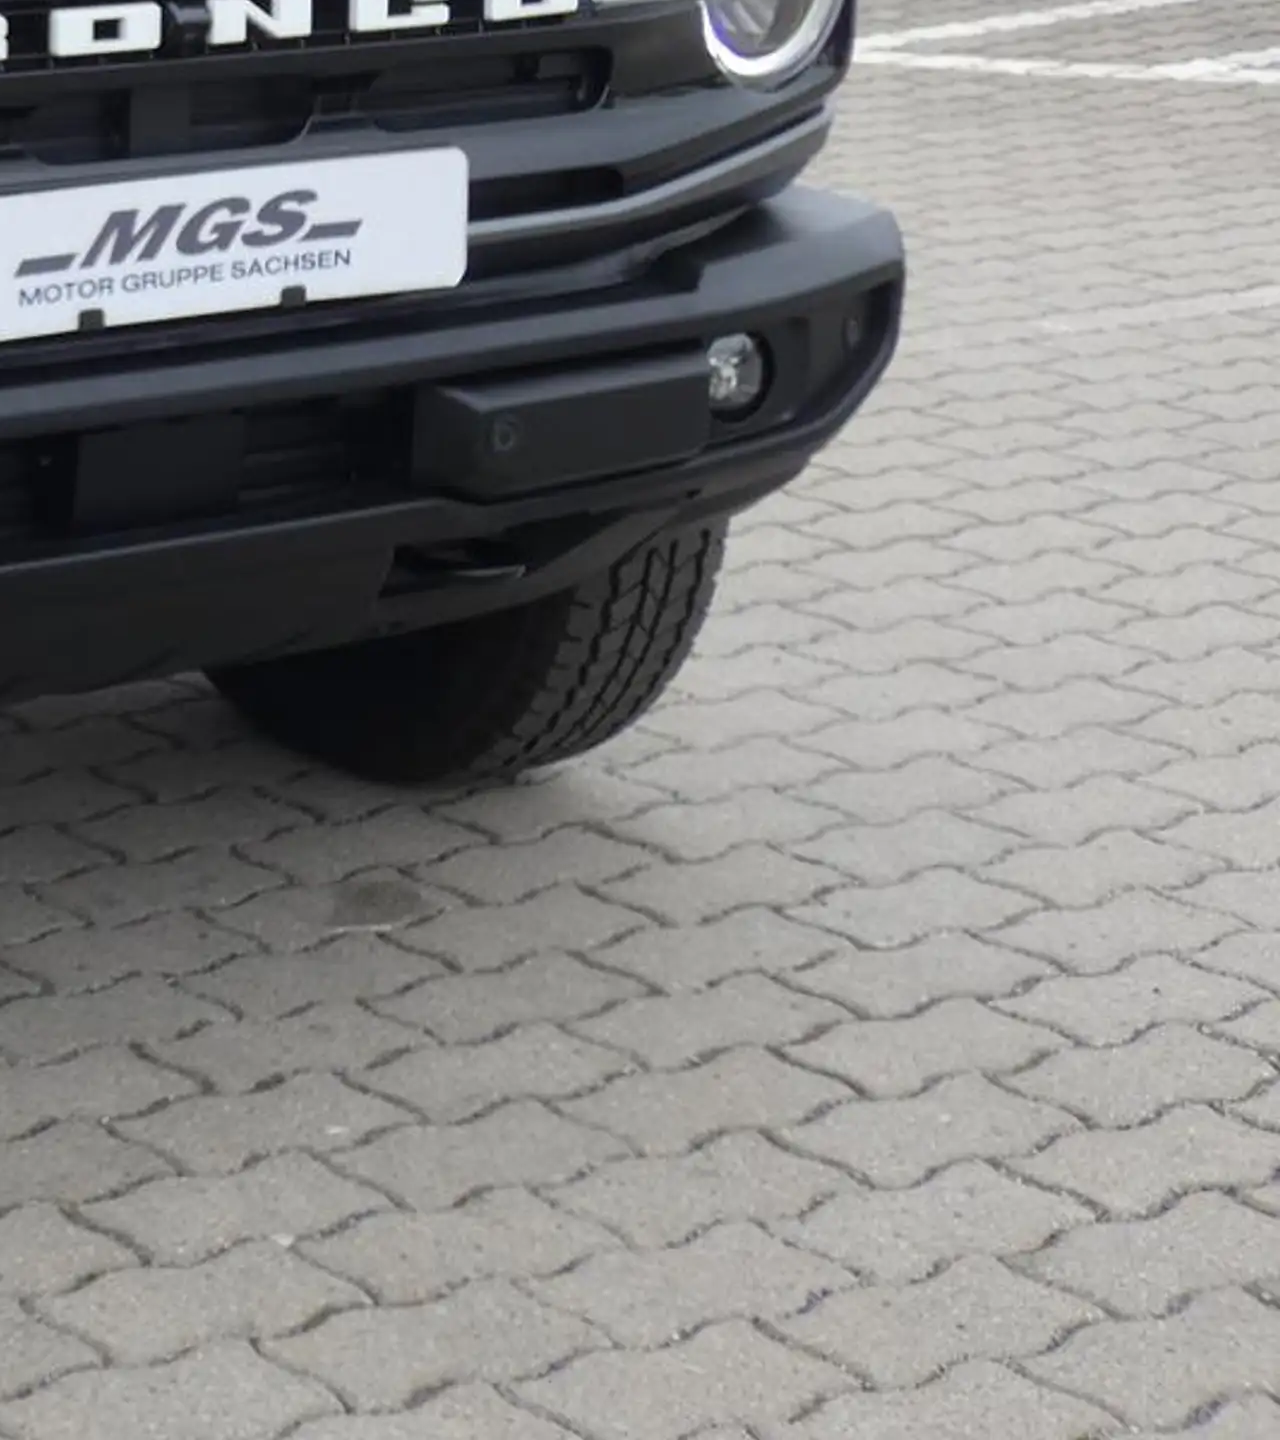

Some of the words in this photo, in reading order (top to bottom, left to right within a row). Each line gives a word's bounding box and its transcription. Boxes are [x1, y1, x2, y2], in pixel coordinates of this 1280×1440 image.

[19, 277, 114, 308] MOTOR
[123, 262, 224, 292] GRUPPE
[231, 249, 351, 278] SACHSEN
